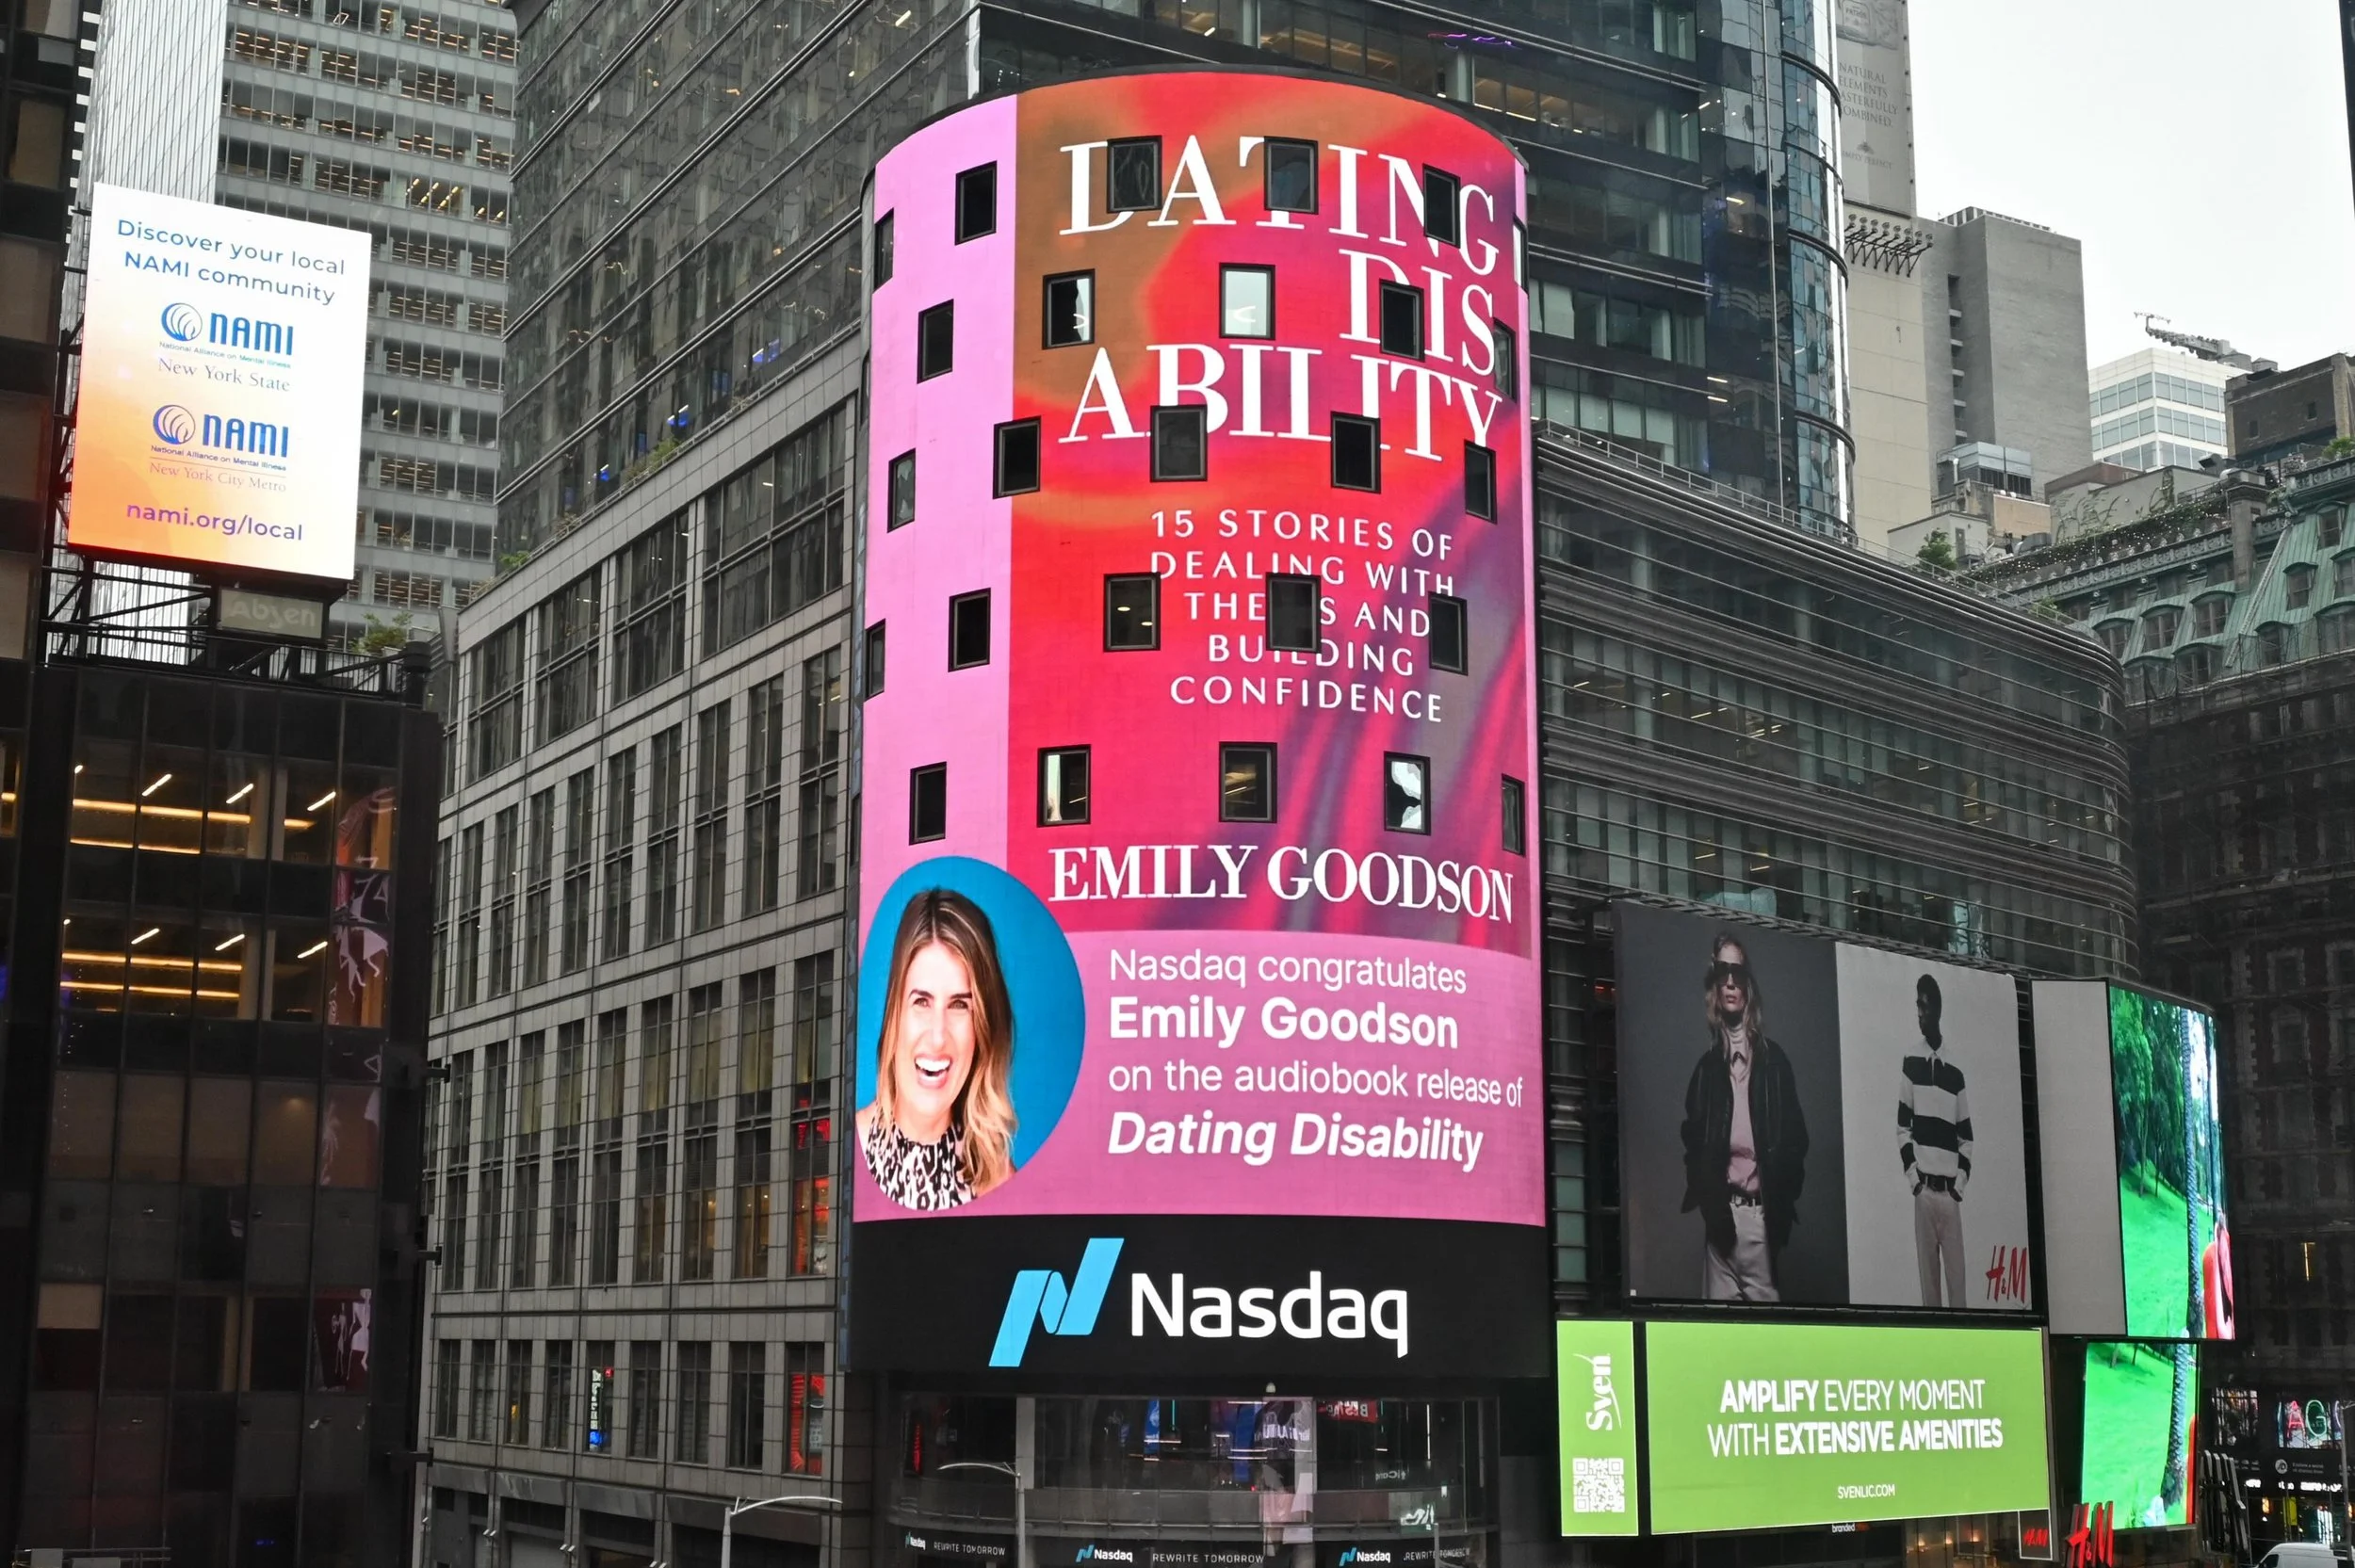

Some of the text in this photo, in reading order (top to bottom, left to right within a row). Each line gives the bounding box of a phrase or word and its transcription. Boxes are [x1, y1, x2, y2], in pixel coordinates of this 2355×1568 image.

[1839, 62, 1886, 84] NATURAL
[1839, 75, 1888, 98] ELEMENTS
[1841, 90, 1898, 115] ASTERFULLY
[117, 218, 345, 275] Discover your local
[124, 251, 335, 306] NAMI community
[209, 313, 294, 356] NAMI
[1339, 249, 1496, 376] DIS
[158, 357, 291, 393] New York State
[159, 342, 191, 353] National
[194, 348, 225, 359] Alliance
[239, 354, 265, 365] Mental
[1058, 343, 1503, 461] ABILITY
[151, 445, 184, 457] National
[187, 450, 219, 461] Alliance
[234, 457, 259, 468] Mental
[203, 413, 289, 459] NAMI
[150, 461, 287, 493] New York City Metro
[126, 501, 302, 542] nami.org/local
[1151, 509, 1453, 562] 15 STORIES OF
[1151, 550, 1454, 597] DEALING WITH
[1183, 591, 1431, 638] THES AND
[1170, 675, 1441, 723] CONFIDENCE
[1048, 845, 1514, 925] EMILY GOODSON
[1110, 948, 1467, 994] Nasdaq congratulates
[1109, 995, 1458, 1049] Emily Goodson
[1108, 1059, 1524, 1108] on the audiobook release of
[1108, 1111, 1485, 1172] Dating Disability
[1986, 1245, 2027, 1303] H&M
[1131, 1270, 1409, 1359] Nasdaq
[1579, 1353, 1621, 1431] Sven
[1721, 1379, 1985, 1414] AMPLIFY EVERY MOMENT
[1707, 1418, 2004, 1457] WITH EXTENSIVE AMENITIES
[1837, 1483, 1895, 1500] SVENLIC.COM
[934, 1541, 1006, 1556] REWRITE TOMORROW
[1831, 1522, 1856, 1533] branded
[2066, 1500, 2113, 1568] H&M
[1094, 1548, 1133, 1563] Nasdaq
[1152, 1552, 1265, 1564] REWRITE TOMORROW
[1356, 1549, 1391, 1563] Nasdaq
[1405, 1550, 1437, 1561] REWRITE
